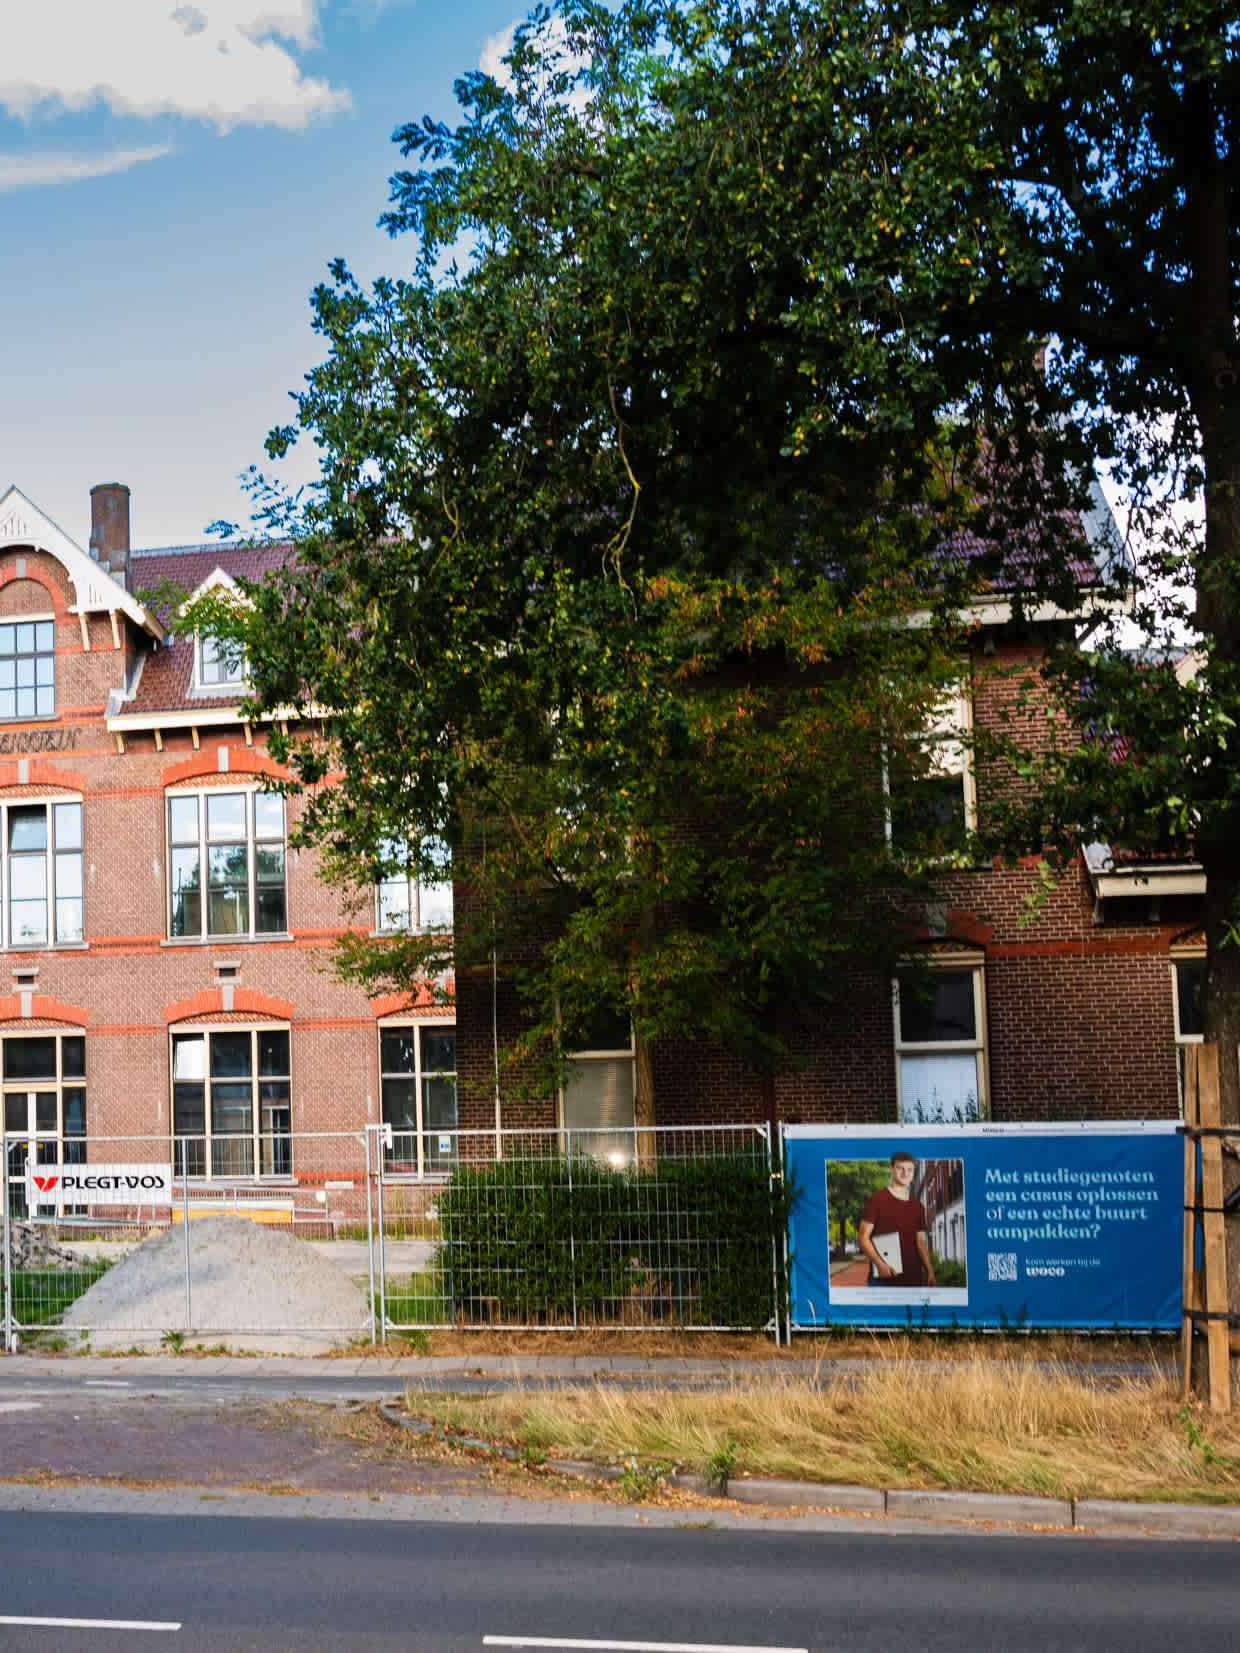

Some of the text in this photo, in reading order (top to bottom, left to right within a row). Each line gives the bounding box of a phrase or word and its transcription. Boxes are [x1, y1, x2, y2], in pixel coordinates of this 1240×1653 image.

[61, 1176, 165, 1190] PLEGT-VOS
[985, 1167, 1155, 1187] Met studiegenoten
[985, 1186, 1159, 1205] een casus oplossen
[986, 1204, 1149, 1221] of een echte buurt
[986, 1223, 1101, 1242] aanpakken?
[1026, 1266, 1065, 1277] woco
